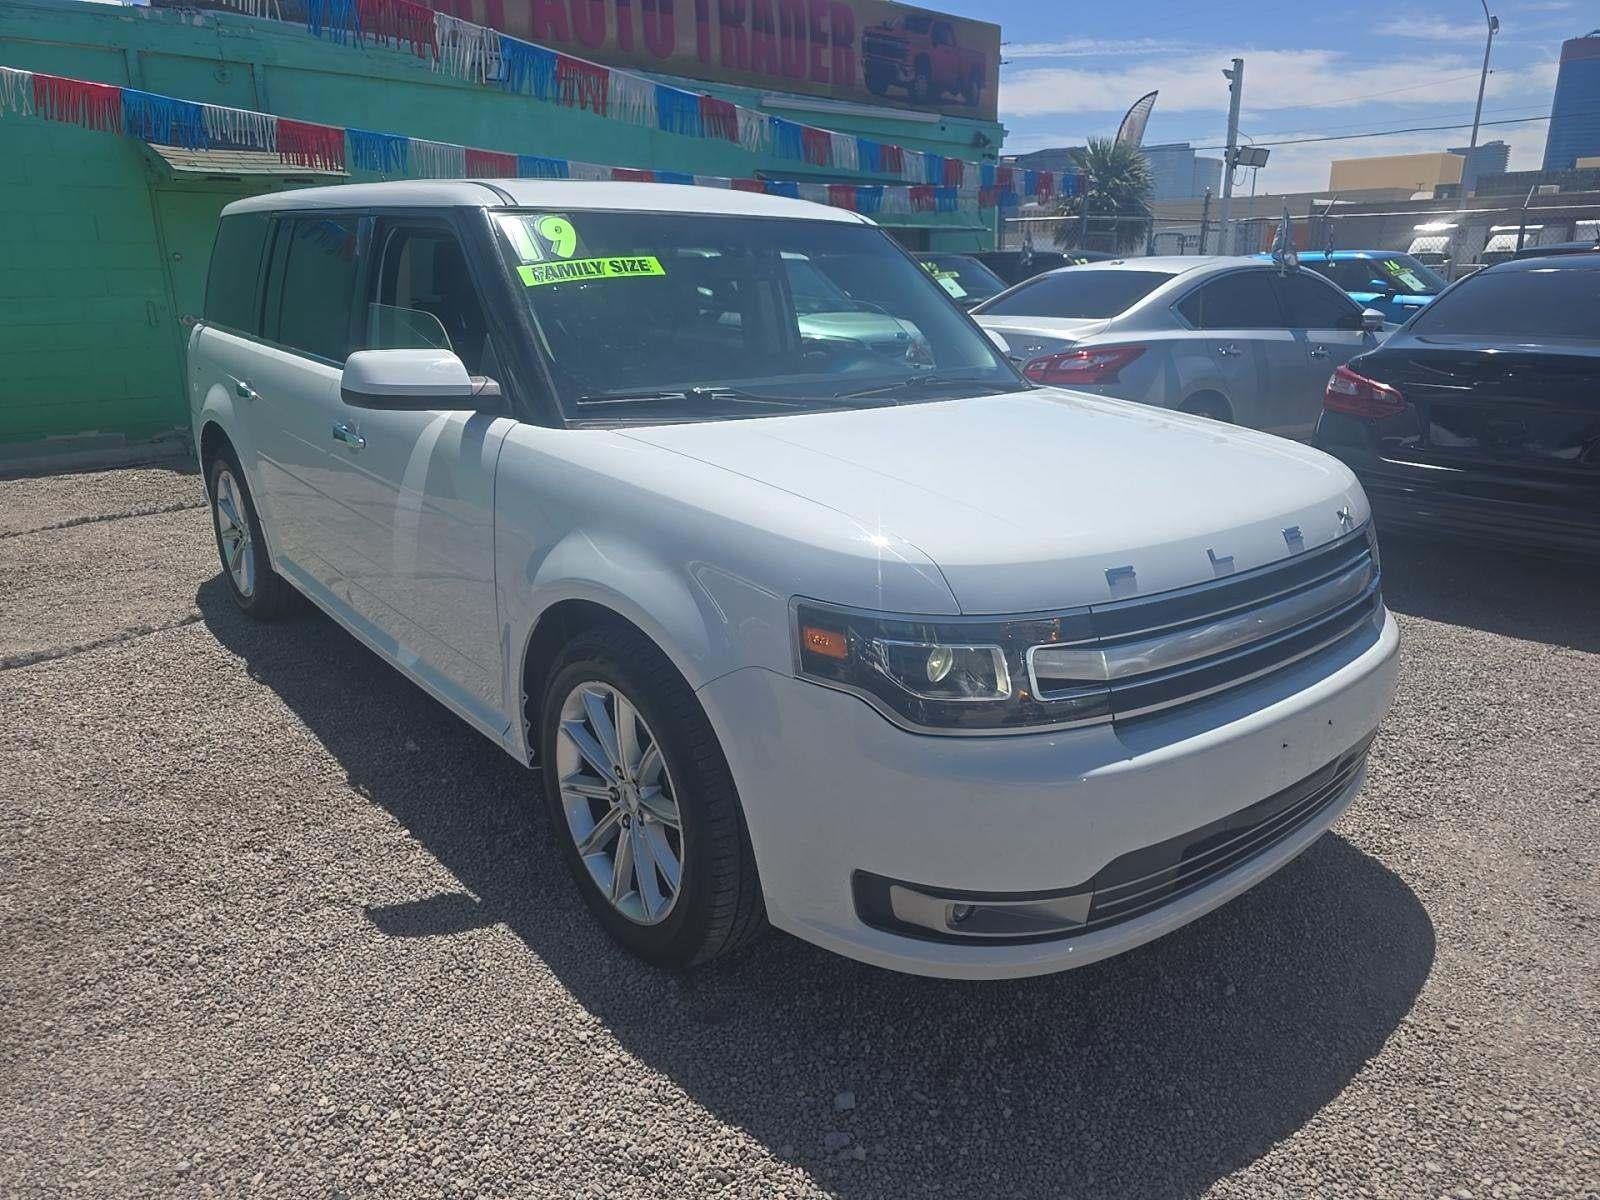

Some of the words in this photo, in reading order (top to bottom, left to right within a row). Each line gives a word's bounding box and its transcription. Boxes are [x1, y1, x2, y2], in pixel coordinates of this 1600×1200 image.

[694, 0, 856, 86] TRADER
[497, 214, 577, 262] 19
[531, 260, 606, 282] FAMILY
[611, 258, 654, 275] SIZE
